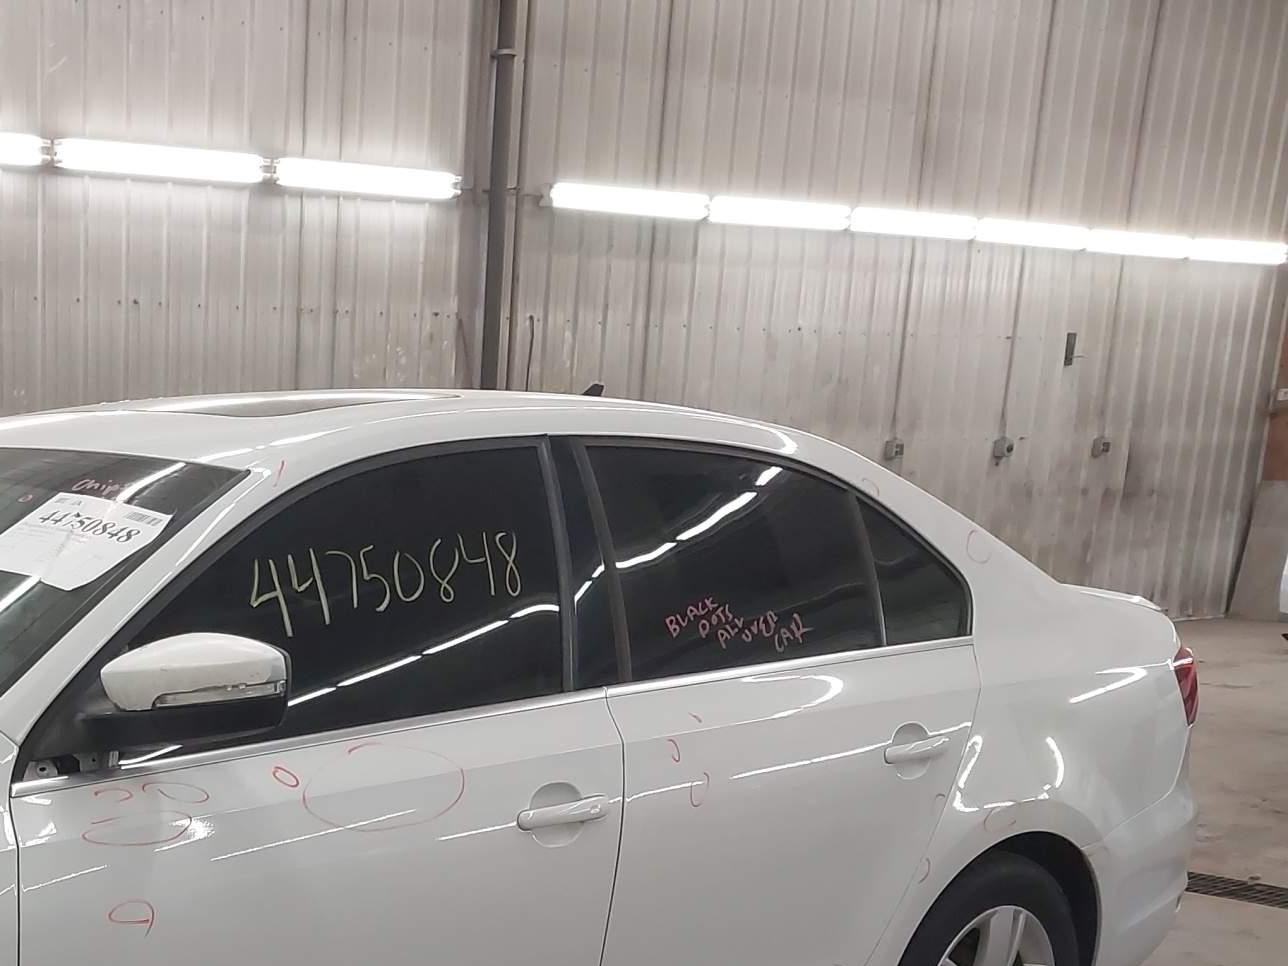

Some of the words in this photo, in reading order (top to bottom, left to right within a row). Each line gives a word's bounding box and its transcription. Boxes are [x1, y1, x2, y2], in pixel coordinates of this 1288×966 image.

[38, 509, 141, 543] 44750848
[249, 529, 522, 637] 44750848
[664, 596, 719, 638] BLACK
[774, 613, 814, 652] CAR
